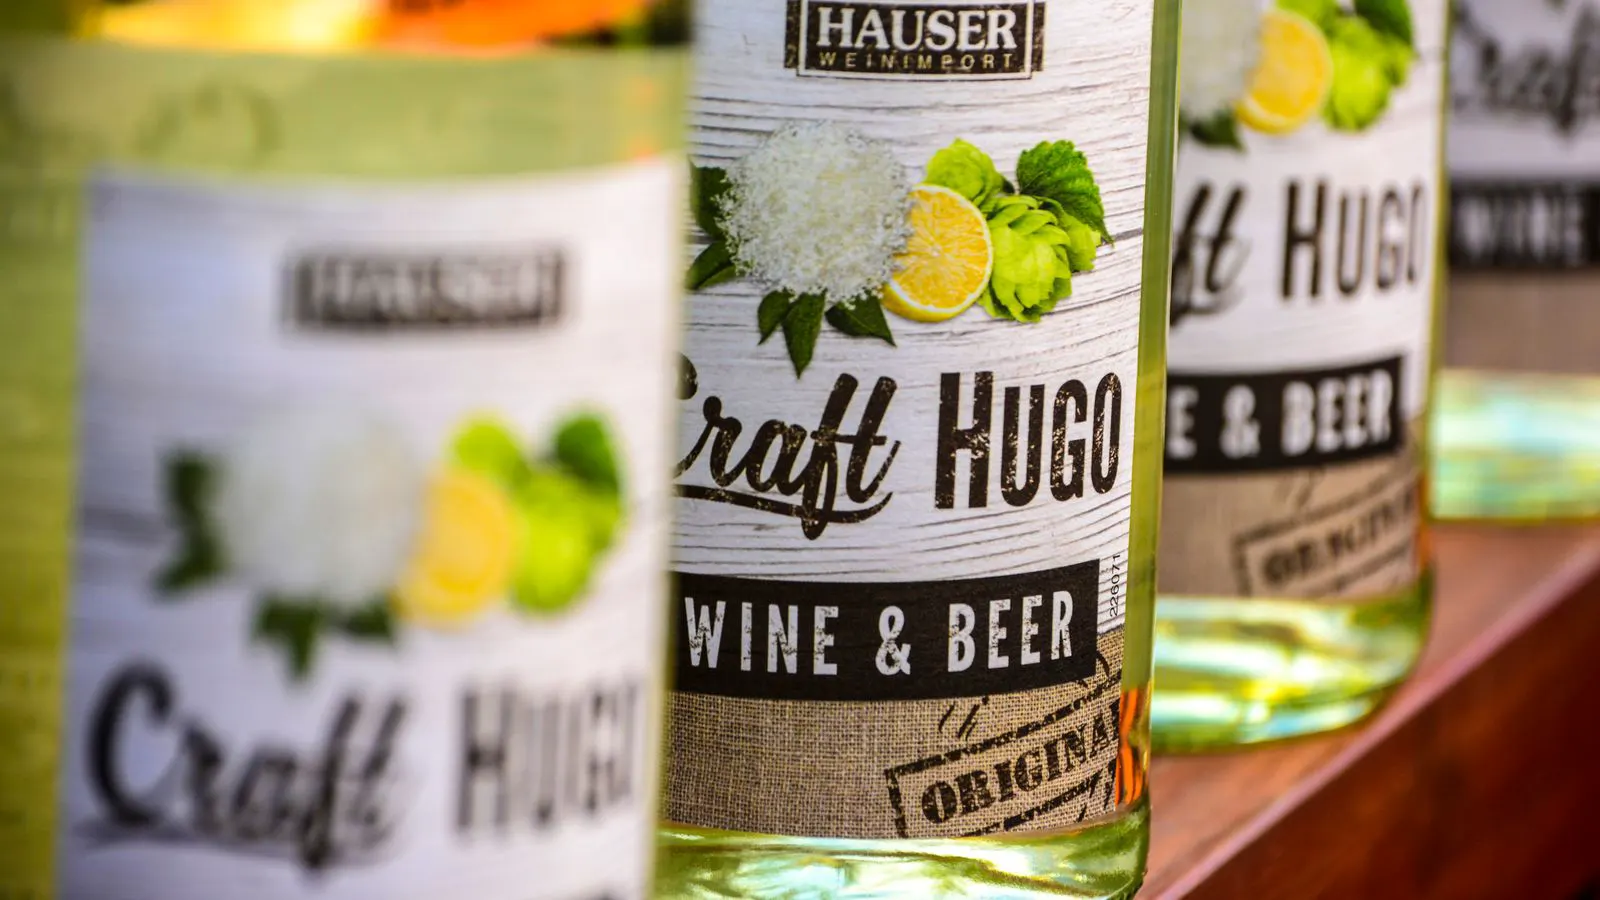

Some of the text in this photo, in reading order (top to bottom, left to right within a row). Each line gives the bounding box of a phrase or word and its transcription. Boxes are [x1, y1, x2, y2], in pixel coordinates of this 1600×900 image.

[816, 6, 1018, 50] HAUSER
[819, 51, 1014, 71] WEINIMPORT
[674, 353, 902, 540] raft
[935, 370, 1122, 510] HUGO
[1219, 383, 1261, 459] &
[1281, 368, 1394, 457] BEER
[1109, 554, 1121, 617] 226071
[684, 589, 1074, 676] WINE & BEER
[86, 662, 408, 868] Craft
